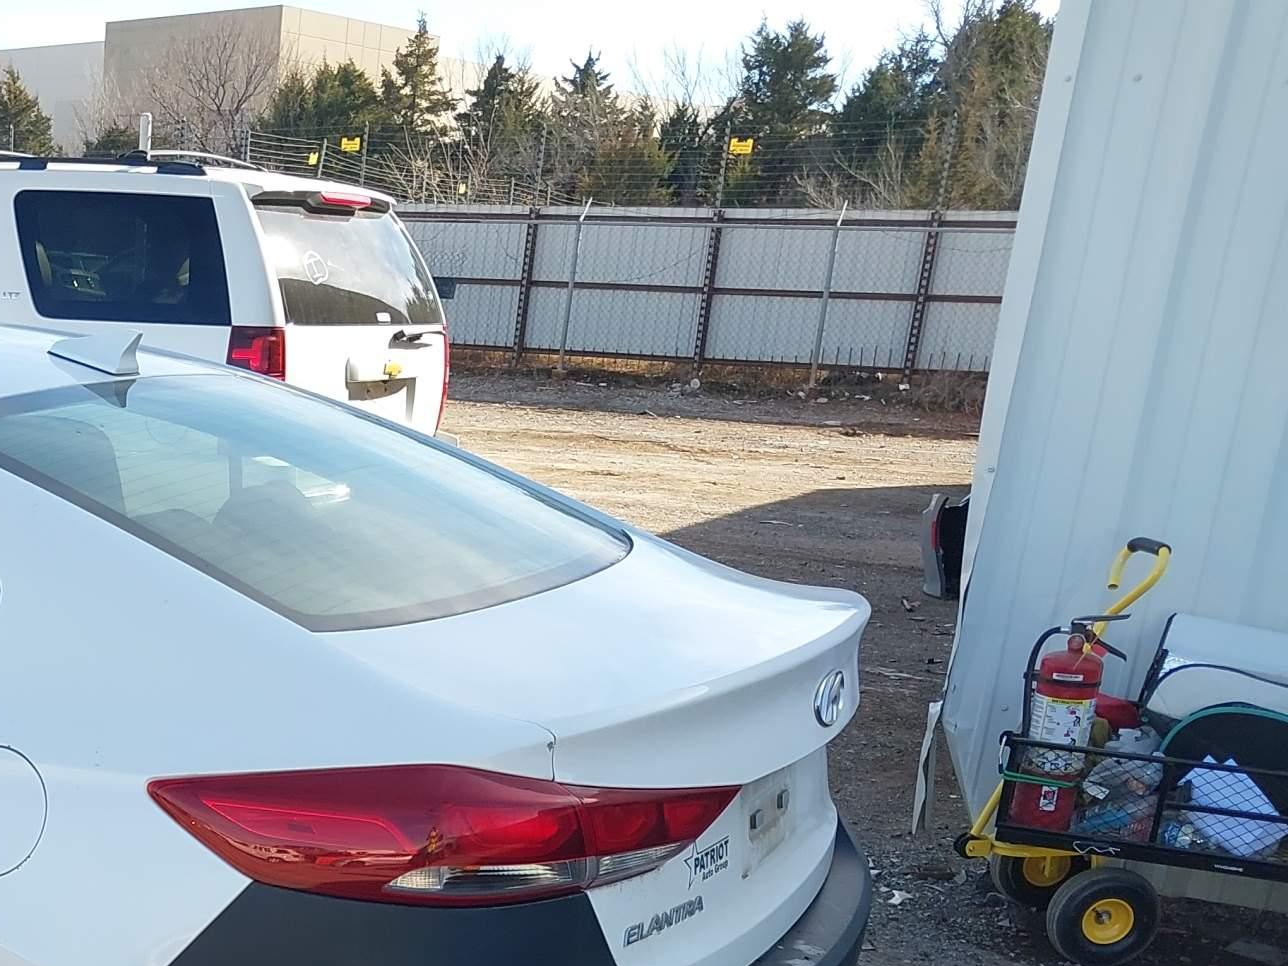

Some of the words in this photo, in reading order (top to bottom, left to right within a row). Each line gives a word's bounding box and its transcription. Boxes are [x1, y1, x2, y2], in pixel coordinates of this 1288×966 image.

[694, 839, 729, 876] PATRIOT
[702, 869, 714, 881] Auto
[623, 895, 704, 948] ELANTRA
